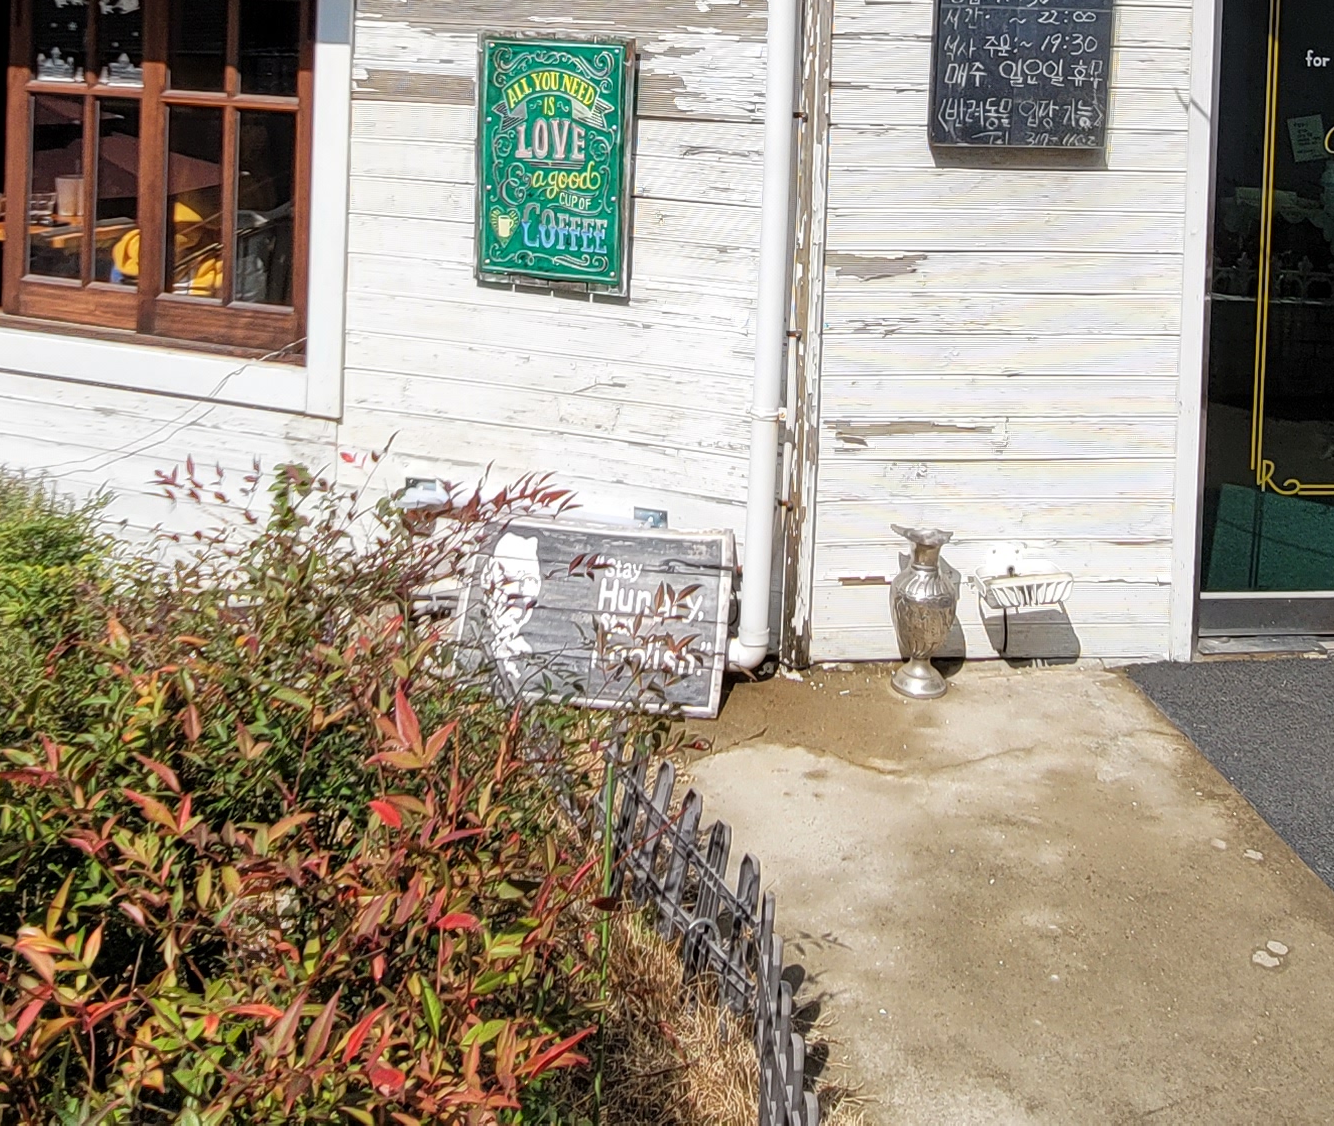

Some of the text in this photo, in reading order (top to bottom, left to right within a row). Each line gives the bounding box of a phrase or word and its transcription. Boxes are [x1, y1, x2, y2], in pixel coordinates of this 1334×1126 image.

[1041, 33, 1098, 56] 19:30
[1305, 49, 1330, 67] for
[944, 62, 987, 87] 매주
[999, 58, 1065, 87] 일요일
[506, 71, 595, 109] ALL YOU NEED
[543, 96, 555, 116] IS
[1019, 99, 1058, 129] 입장
[514, 117, 586, 160] LOVE
[532, 170, 547, 188] a
[547, 161, 601, 199] good
[559, 192, 592, 210] CUP OF
[521, 202, 608, 254] COFFEE
